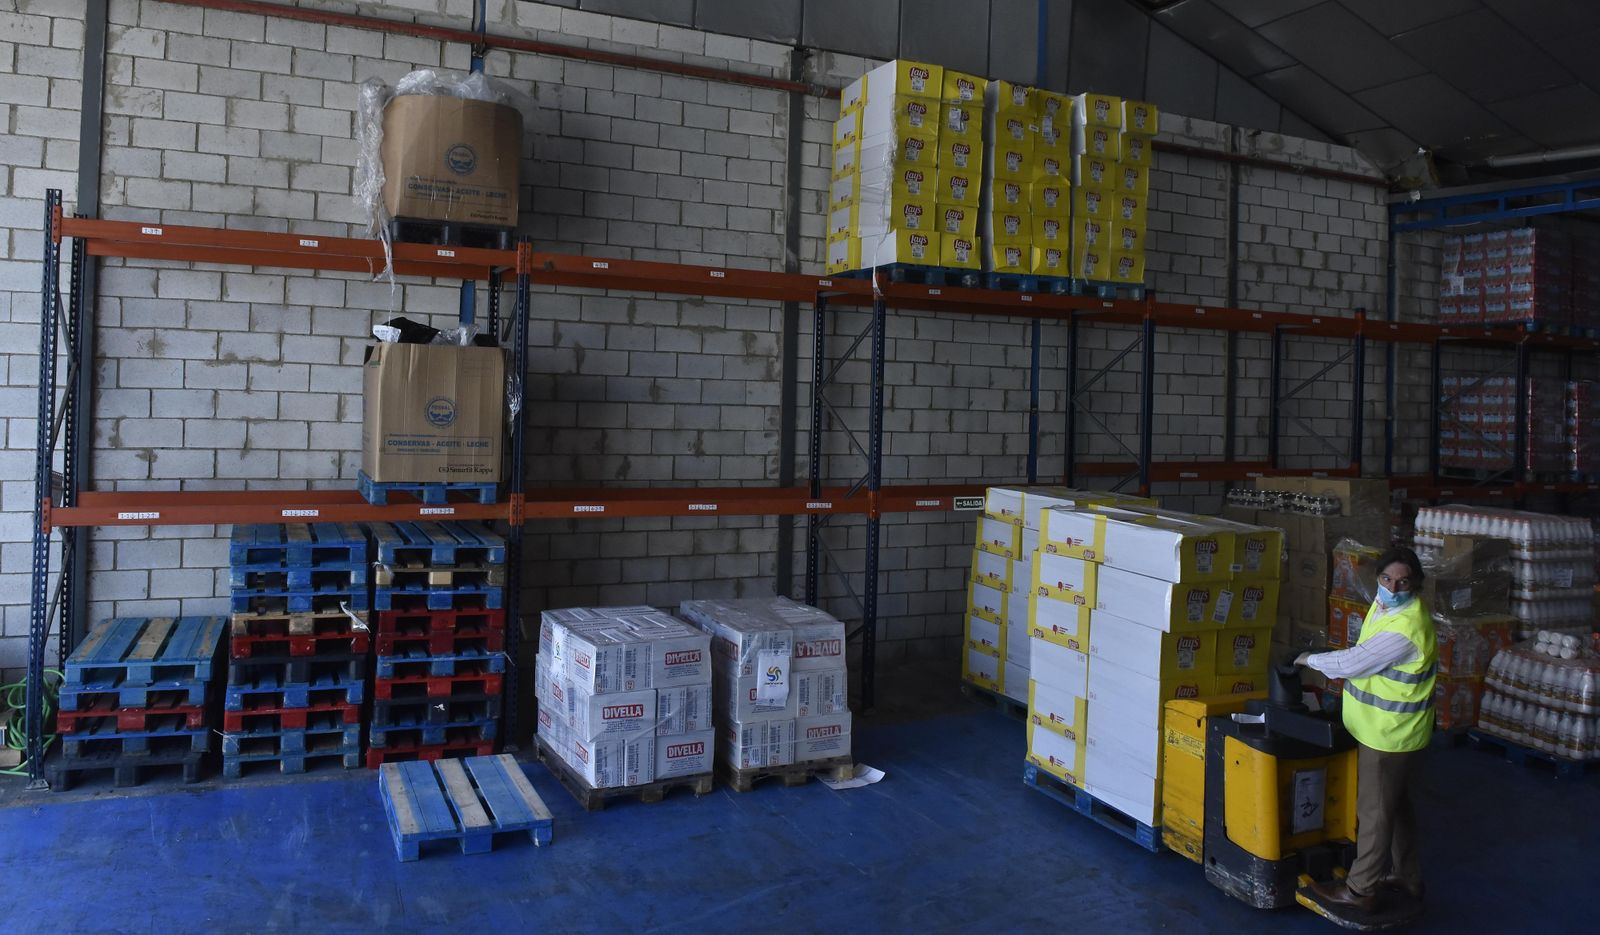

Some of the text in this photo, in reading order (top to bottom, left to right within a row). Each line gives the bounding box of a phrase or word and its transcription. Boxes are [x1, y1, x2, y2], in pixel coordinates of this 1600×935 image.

[911, 68, 928, 78] Lay's
[958, 79, 974, 90] Lay's
[908, 103, 926, 114] Lay's
[906, 138, 924, 150] Lay's
[952, 144, 970, 154] Lay's
[906, 170, 923, 182] Lay's
[951, 176, 968, 188] Lay's
[905, 205, 922, 216] Lay's
[946, 210, 964, 220] Lay's
[910, 234, 928, 246] Lay's
[955, 239, 972, 250] Lay's
[1196, 540, 1217, 552] Lay's
[1247, 540, 1265, 552] Lay's
[1188, 590, 1209, 603] Lay's
[1243, 588, 1263, 601] Lay's
[1178, 637, 1200, 650] Lay's
[1234, 636, 1254, 649] Lay's
[797, 640, 840, 658] DIVELLA
[666, 652, 700, 664] DIVELLA
[1177, 686, 1197, 697] Lay's
[604, 706, 642, 718] DIVELLA
[808, 726, 840, 738] DIVELLA
[669, 744, 703, 758] DIVELLA
